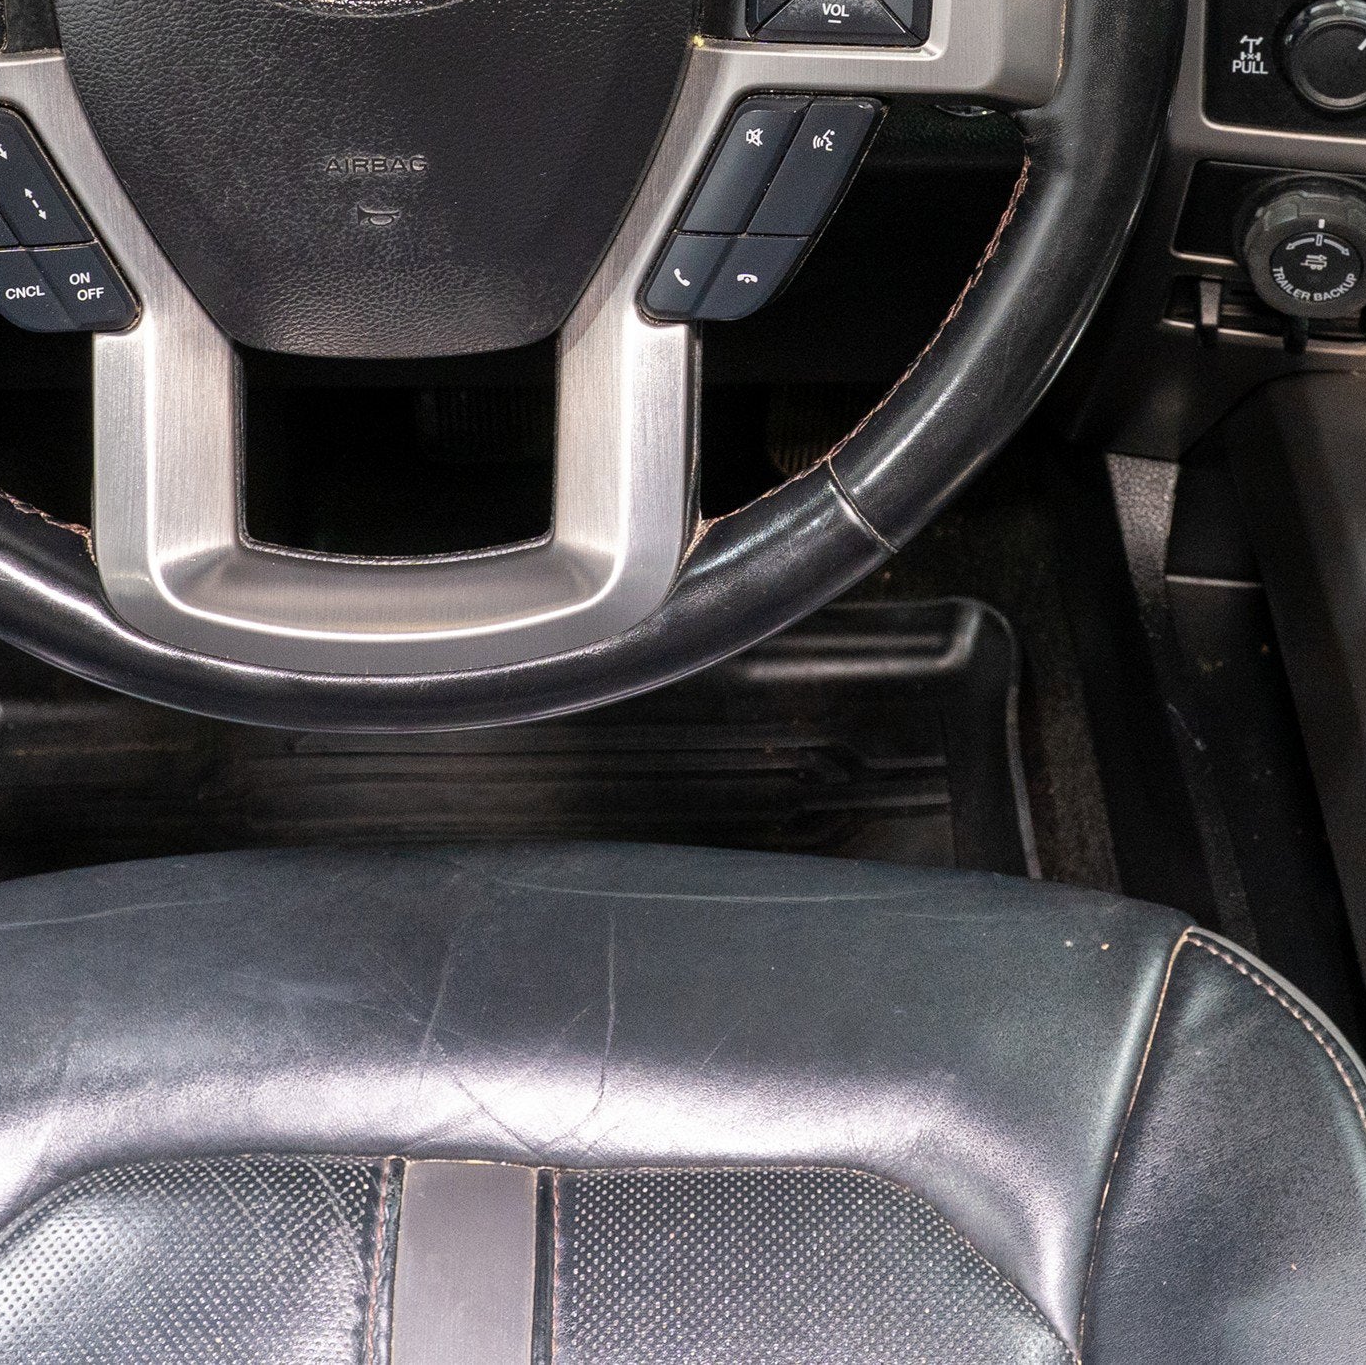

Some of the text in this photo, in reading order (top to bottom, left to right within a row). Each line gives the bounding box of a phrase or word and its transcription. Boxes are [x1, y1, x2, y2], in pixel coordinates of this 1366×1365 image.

[822, 3, 850, 18] VOL
[1232, 60, 1268, 75] PULL
[324, 155, 428, 174] AIRBAG
[69, 272, 91, 285] ON
[1272, 266, 1357, 302] TRAILER BACKUP
[5, 285, 45, 300] CNCL
[77, 287, 105, 301] OFF
